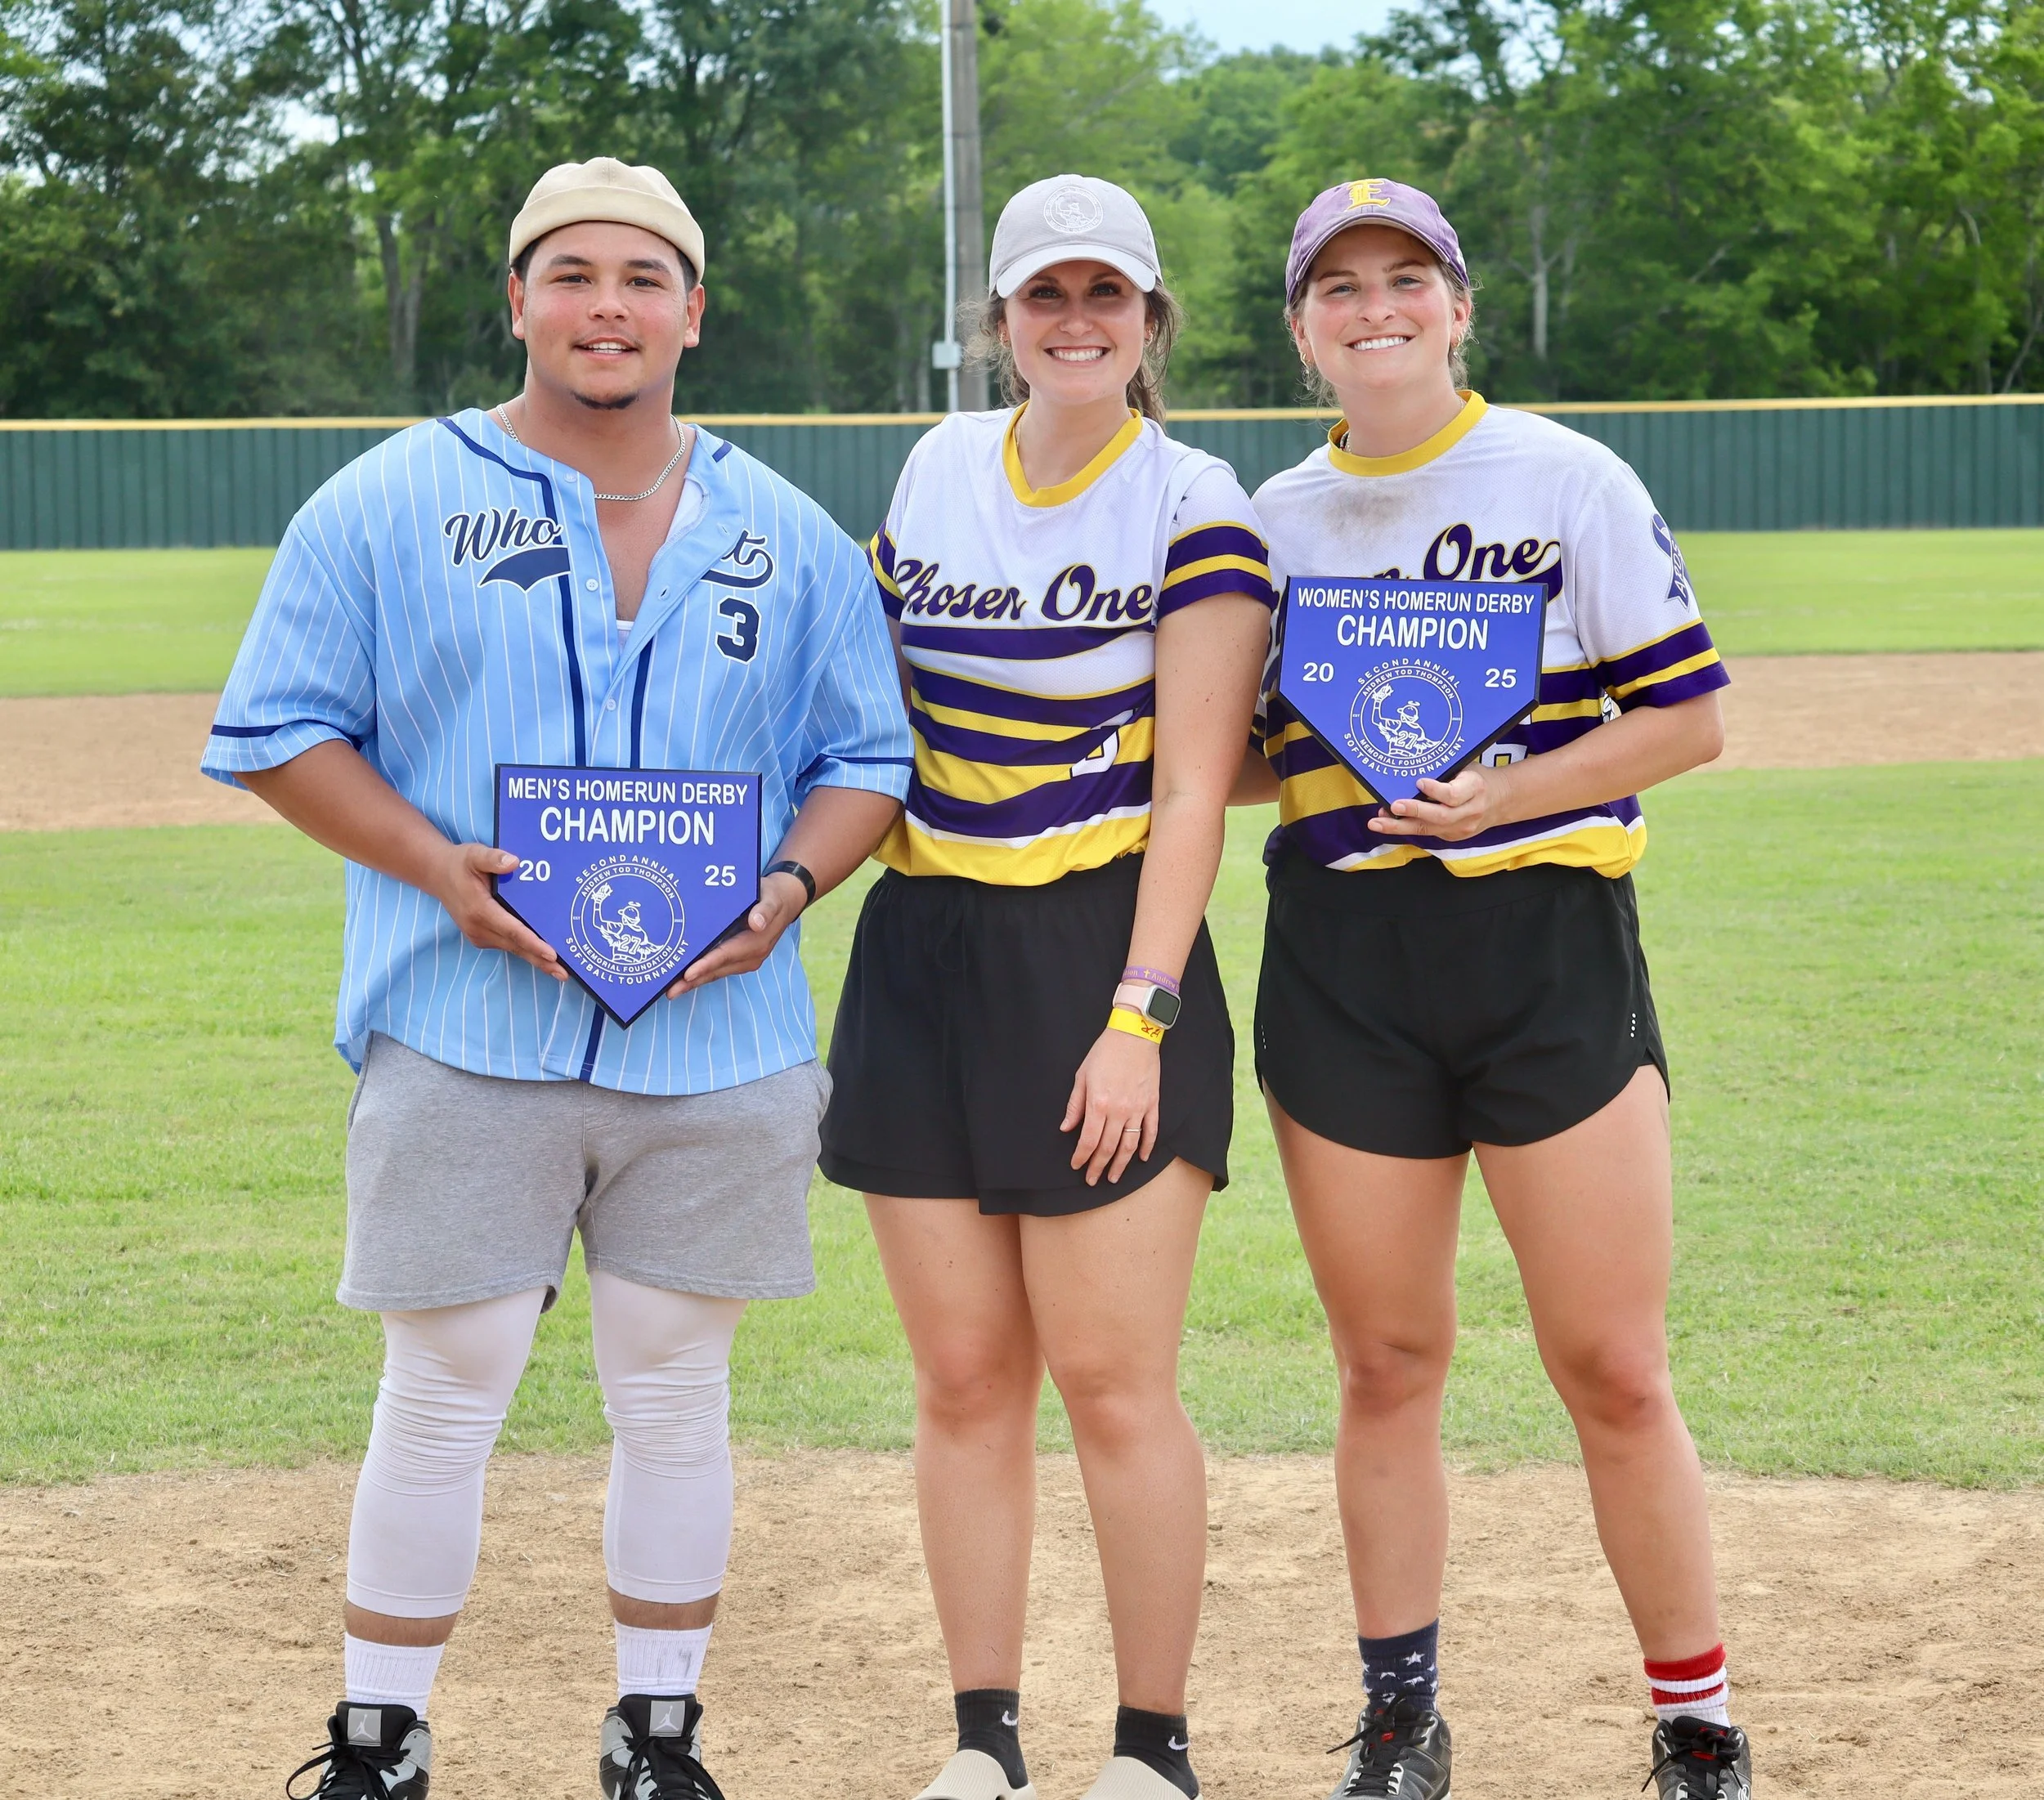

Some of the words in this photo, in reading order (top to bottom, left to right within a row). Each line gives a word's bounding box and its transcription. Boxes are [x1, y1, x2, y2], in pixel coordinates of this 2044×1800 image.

[443, 507, 562, 566] Who
[1423, 522, 1560, 581] One
[1041, 562, 1154, 621] One
[1298, 587, 1380, 610] WOMEN'S
[1384, 590, 1472, 612] HOMERUN
[1476, 593, 1535, 614] DERBY
[715, 598, 761, 665] 3
[1337, 615, 1489, 651] CHAMPION
[1302, 662, 1334, 683] 20
[1358, 658, 1410, 685] SECOND
[1414, 659, 1460, 688] ANNUAL
[1362, 672, 1392, 696] ANDREW
[1416, 670, 1455, 700] THOMPSON
[1484, 668, 1517, 688] 25
[1344, 732, 1388, 775] SOFTBALL
[1393, 737, 1465, 777] TOURNAMENT
[1360, 739, 1396, 765] MEMORIAL
[1398, 741, 1449, 766] FOUNDATION
[1394, 731, 1419, 750] 27
[508, 777, 571, 800] MEN'S
[576, 780, 676, 804] HOMERUN
[681, 782, 748, 805] DERBY
[540, 806, 715, 846] CHAMPION
[518, 860, 551, 882] 20
[576, 854, 626, 884] SECOND
[632, 855, 679, 887] ANNUAL
[580, 870, 611, 898] ANDREW
[634, 867, 675, 899] THOMPSON
[704, 865, 737, 887] 25
[582, 943, 621, 972] MEMORIAL
[623, 945, 673, 973] FOUNDATION
[617, 934, 641, 955] 27
[566, 937, 614, 983] SOFTBALL
[618, 940, 689, 984] TOURNAMENT
